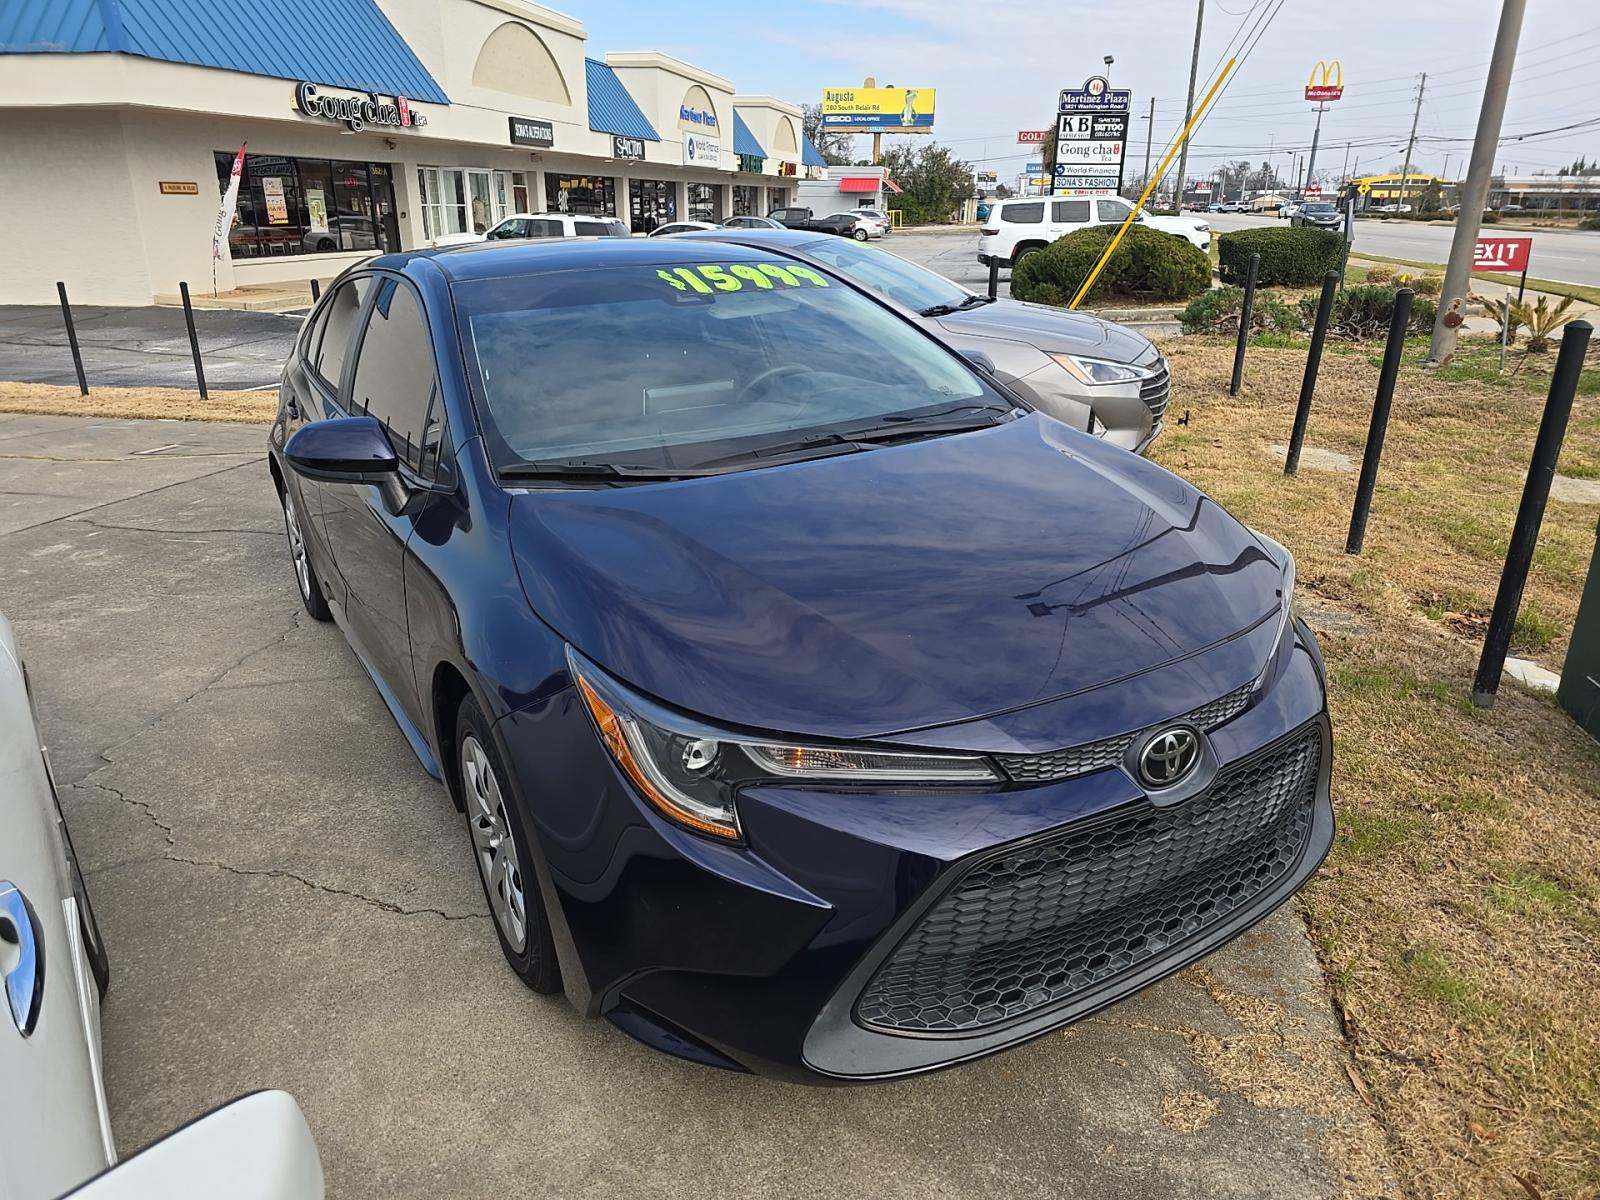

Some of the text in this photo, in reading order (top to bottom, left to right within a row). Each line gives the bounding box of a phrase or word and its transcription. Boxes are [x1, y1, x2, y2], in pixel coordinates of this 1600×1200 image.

[826, 90, 854, 104] Augusta
[1062, 93, 1128, 103] Martinez Plaza
[297, 81, 364, 132] Gong
[364, 92, 400, 126] cha
[1062, 117, 1089, 132] K B
[1093, 123, 1124, 131] TATTOO
[1060, 143, 1090, 158] Gong
[1092, 143, 1112, 155] cha
[1056, 178, 1116, 187] SONA'S FASHION
[1473, 243, 1519, 259] EXIT
[655, 263, 830, 294] $15999
